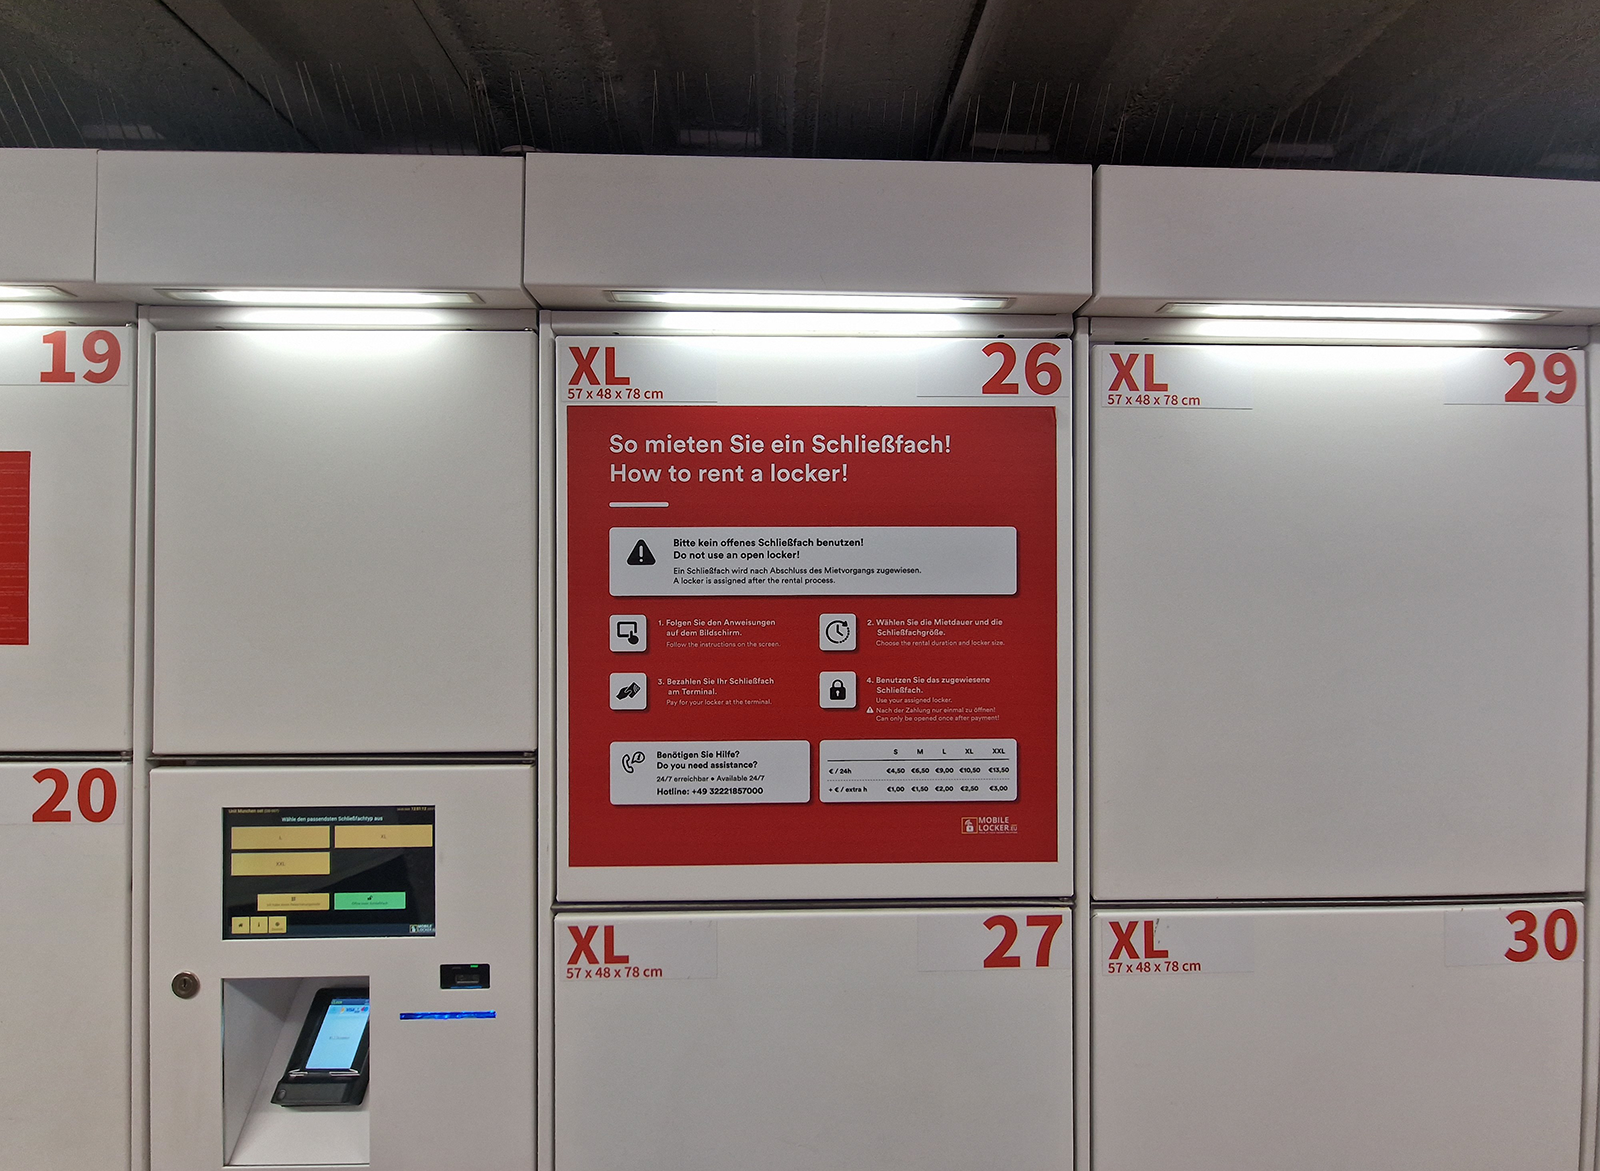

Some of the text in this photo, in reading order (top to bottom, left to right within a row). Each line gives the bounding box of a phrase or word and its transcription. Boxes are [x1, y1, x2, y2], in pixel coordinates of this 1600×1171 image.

[40, 330, 121, 384] 19
[569, 347, 631, 386] XL
[982, 342, 1062, 396] 26
[1108, 353, 1168, 392] XL
[1504, 351, 1576, 404] 29
[568, 388, 664, 400] 57 x 48 x 78 cm
[1107, 393, 1201, 406] 57 x 48 x 78 cm
[609, 434, 950, 454] So mieten Sie ein Schließfach!
[610, 463, 847, 482] How to rent a locker!
[673, 538, 864, 547] Bitte kein offenes Schließfach benutzen!
[673, 550, 687, 560] Do
[689, 551, 705, 560] not
[740, 552, 765, 561] open
[767, 550, 800, 559] locker!
[673, 567, 685, 575] Ein
[686, 566, 730, 575] Schließfach
[824, 566, 875, 576] Mietvorgangs
[876, 566, 922, 576] zugewiesen.
[705, 576, 712, 584] is
[713, 576, 746, 586] assigned
[666, 619, 692, 628] Folgen
[693, 618, 706, 626] Sie
[723, 618, 776, 628] Anweisungen
[877, 628, 946, 638] Schließfachgröße.
[941, 676, 990, 685] zugewiesene
[681, 688, 718, 696] Terminal.
[904, 696, 931, 704] assigned
[905, 706, 931, 715] Zahlung
[656, 750, 740, 761] Benötigen Sie Hilfe?
[656, 760, 758, 771] Do you need assistance?
[32, 768, 118, 823] 20
[656, 787, 764, 796] Hotline: +49 32221857000
[978, 816, 1009, 824] MOBILE
[983, 914, 1063, 968] 27
[1108, 920, 1169, 960] XL
[1504, 908, 1578, 963] 30
[567, 925, 630, 965] XL
[566, 966, 663, 980] 57 x 48 x 78 cm
[1107, 960, 1202, 974] 57 x 48 x 78 cm
